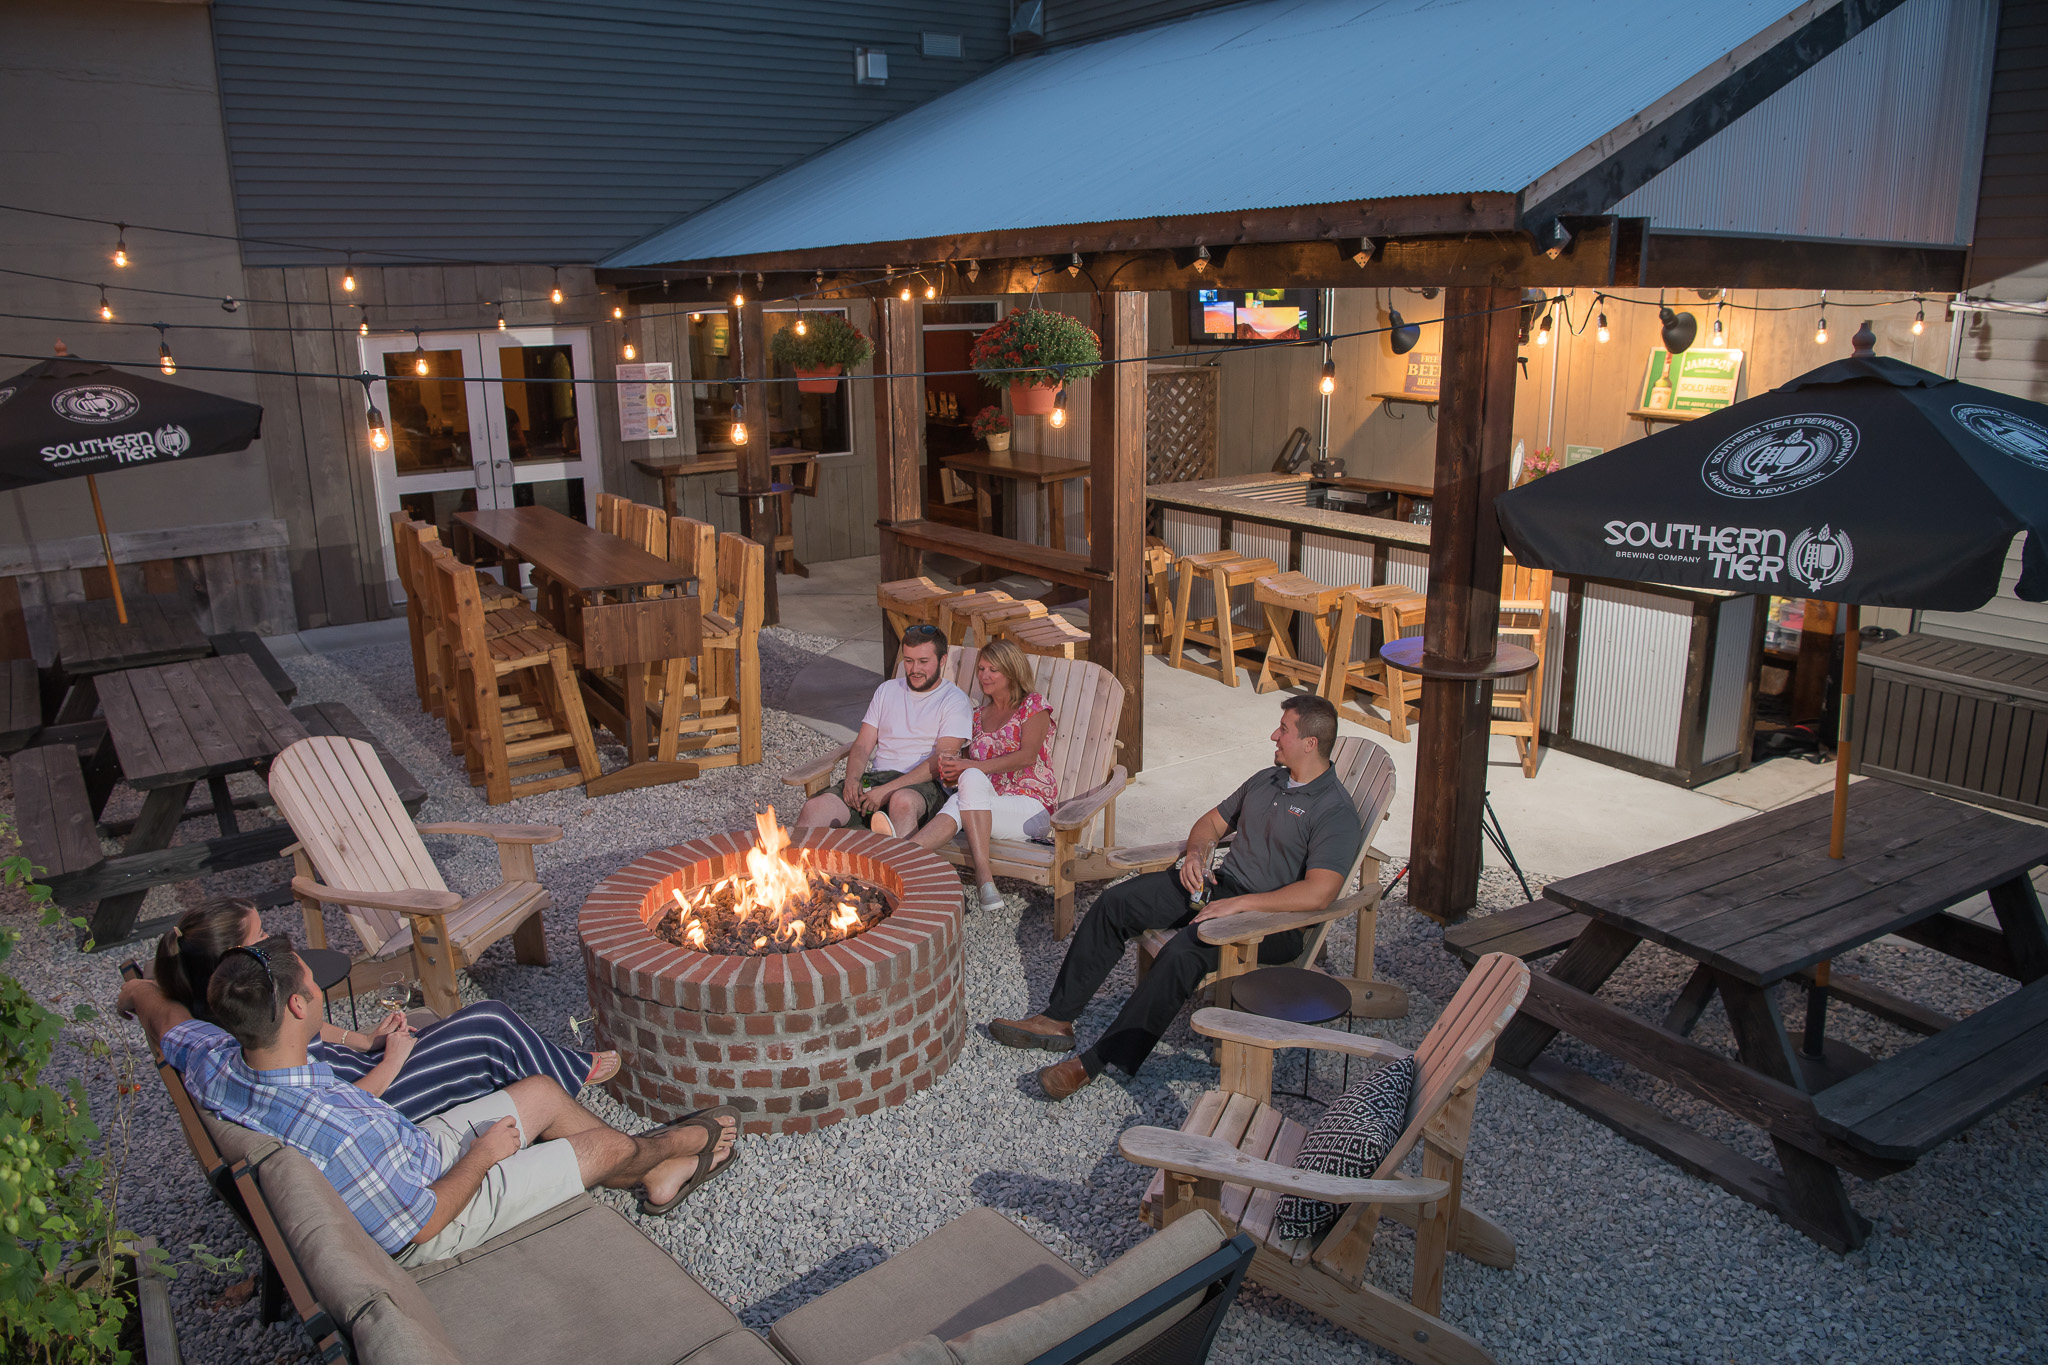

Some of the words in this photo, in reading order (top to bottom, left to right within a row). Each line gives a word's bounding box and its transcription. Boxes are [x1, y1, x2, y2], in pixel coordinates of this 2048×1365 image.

[1408, 363, 1441, 376] BEE
[1684, 358, 1735, 372] JAMESON
[1417, 378, 1437, 386] HERE
[1681, 383, 1704, 393] SOLD
[1705, 384, 1729, 394] HERE
[40, 431, 154, 462] SOUTHERN
[1711, 427, 1761, 464] SOUTHERN
[1762, 419, 1792, 430] TIER
[1793, 417, 1845, 431] BREWING
[1832, 428, 1853, 465] COMPANY
[53, 458, 80, 468] BREWING
[81, 455, 110, 463] COMPANY
[112, 444, 158, 464] TIER
[1709, 471, 1752, 496] LAKEWOOD,
[1755, 485, 1787, 495] NEW
[1789, 471, 1826, 488] YORK
[1603, 520, 1787, 557] SOUTHERN
[1615, 551, 1655, 560] BREWING
[1657, 553, 1701, 564] COMPANY
[1708, 552, 1785, 583] TIER
